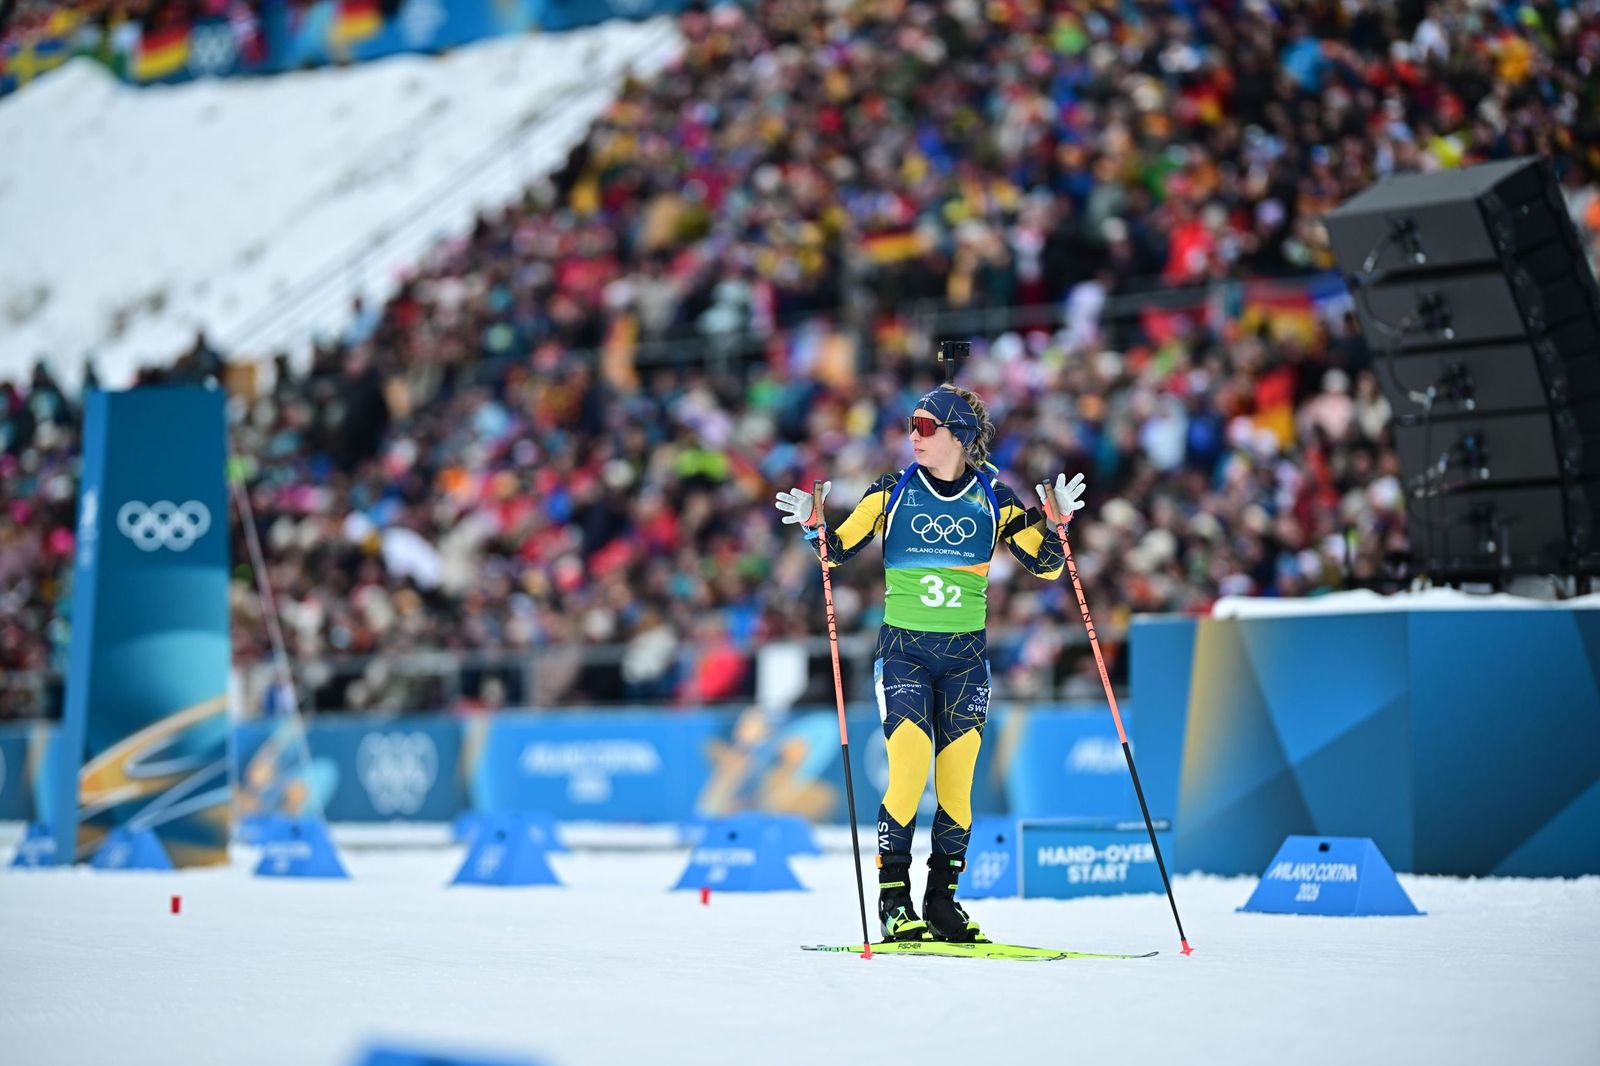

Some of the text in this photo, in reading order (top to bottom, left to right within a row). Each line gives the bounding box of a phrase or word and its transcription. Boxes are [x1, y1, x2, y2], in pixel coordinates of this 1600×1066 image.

[934, 548, 962, 556] CORTINA
[877, 820, 890, 853] SW
[1037, 844, 1156, 867] HAND-OVER
[1066, 864, 1130, 884] START
[1268, 861, 1358, 882] MILANO CORTINA
[897, 942, 922, 950] FISCHER
